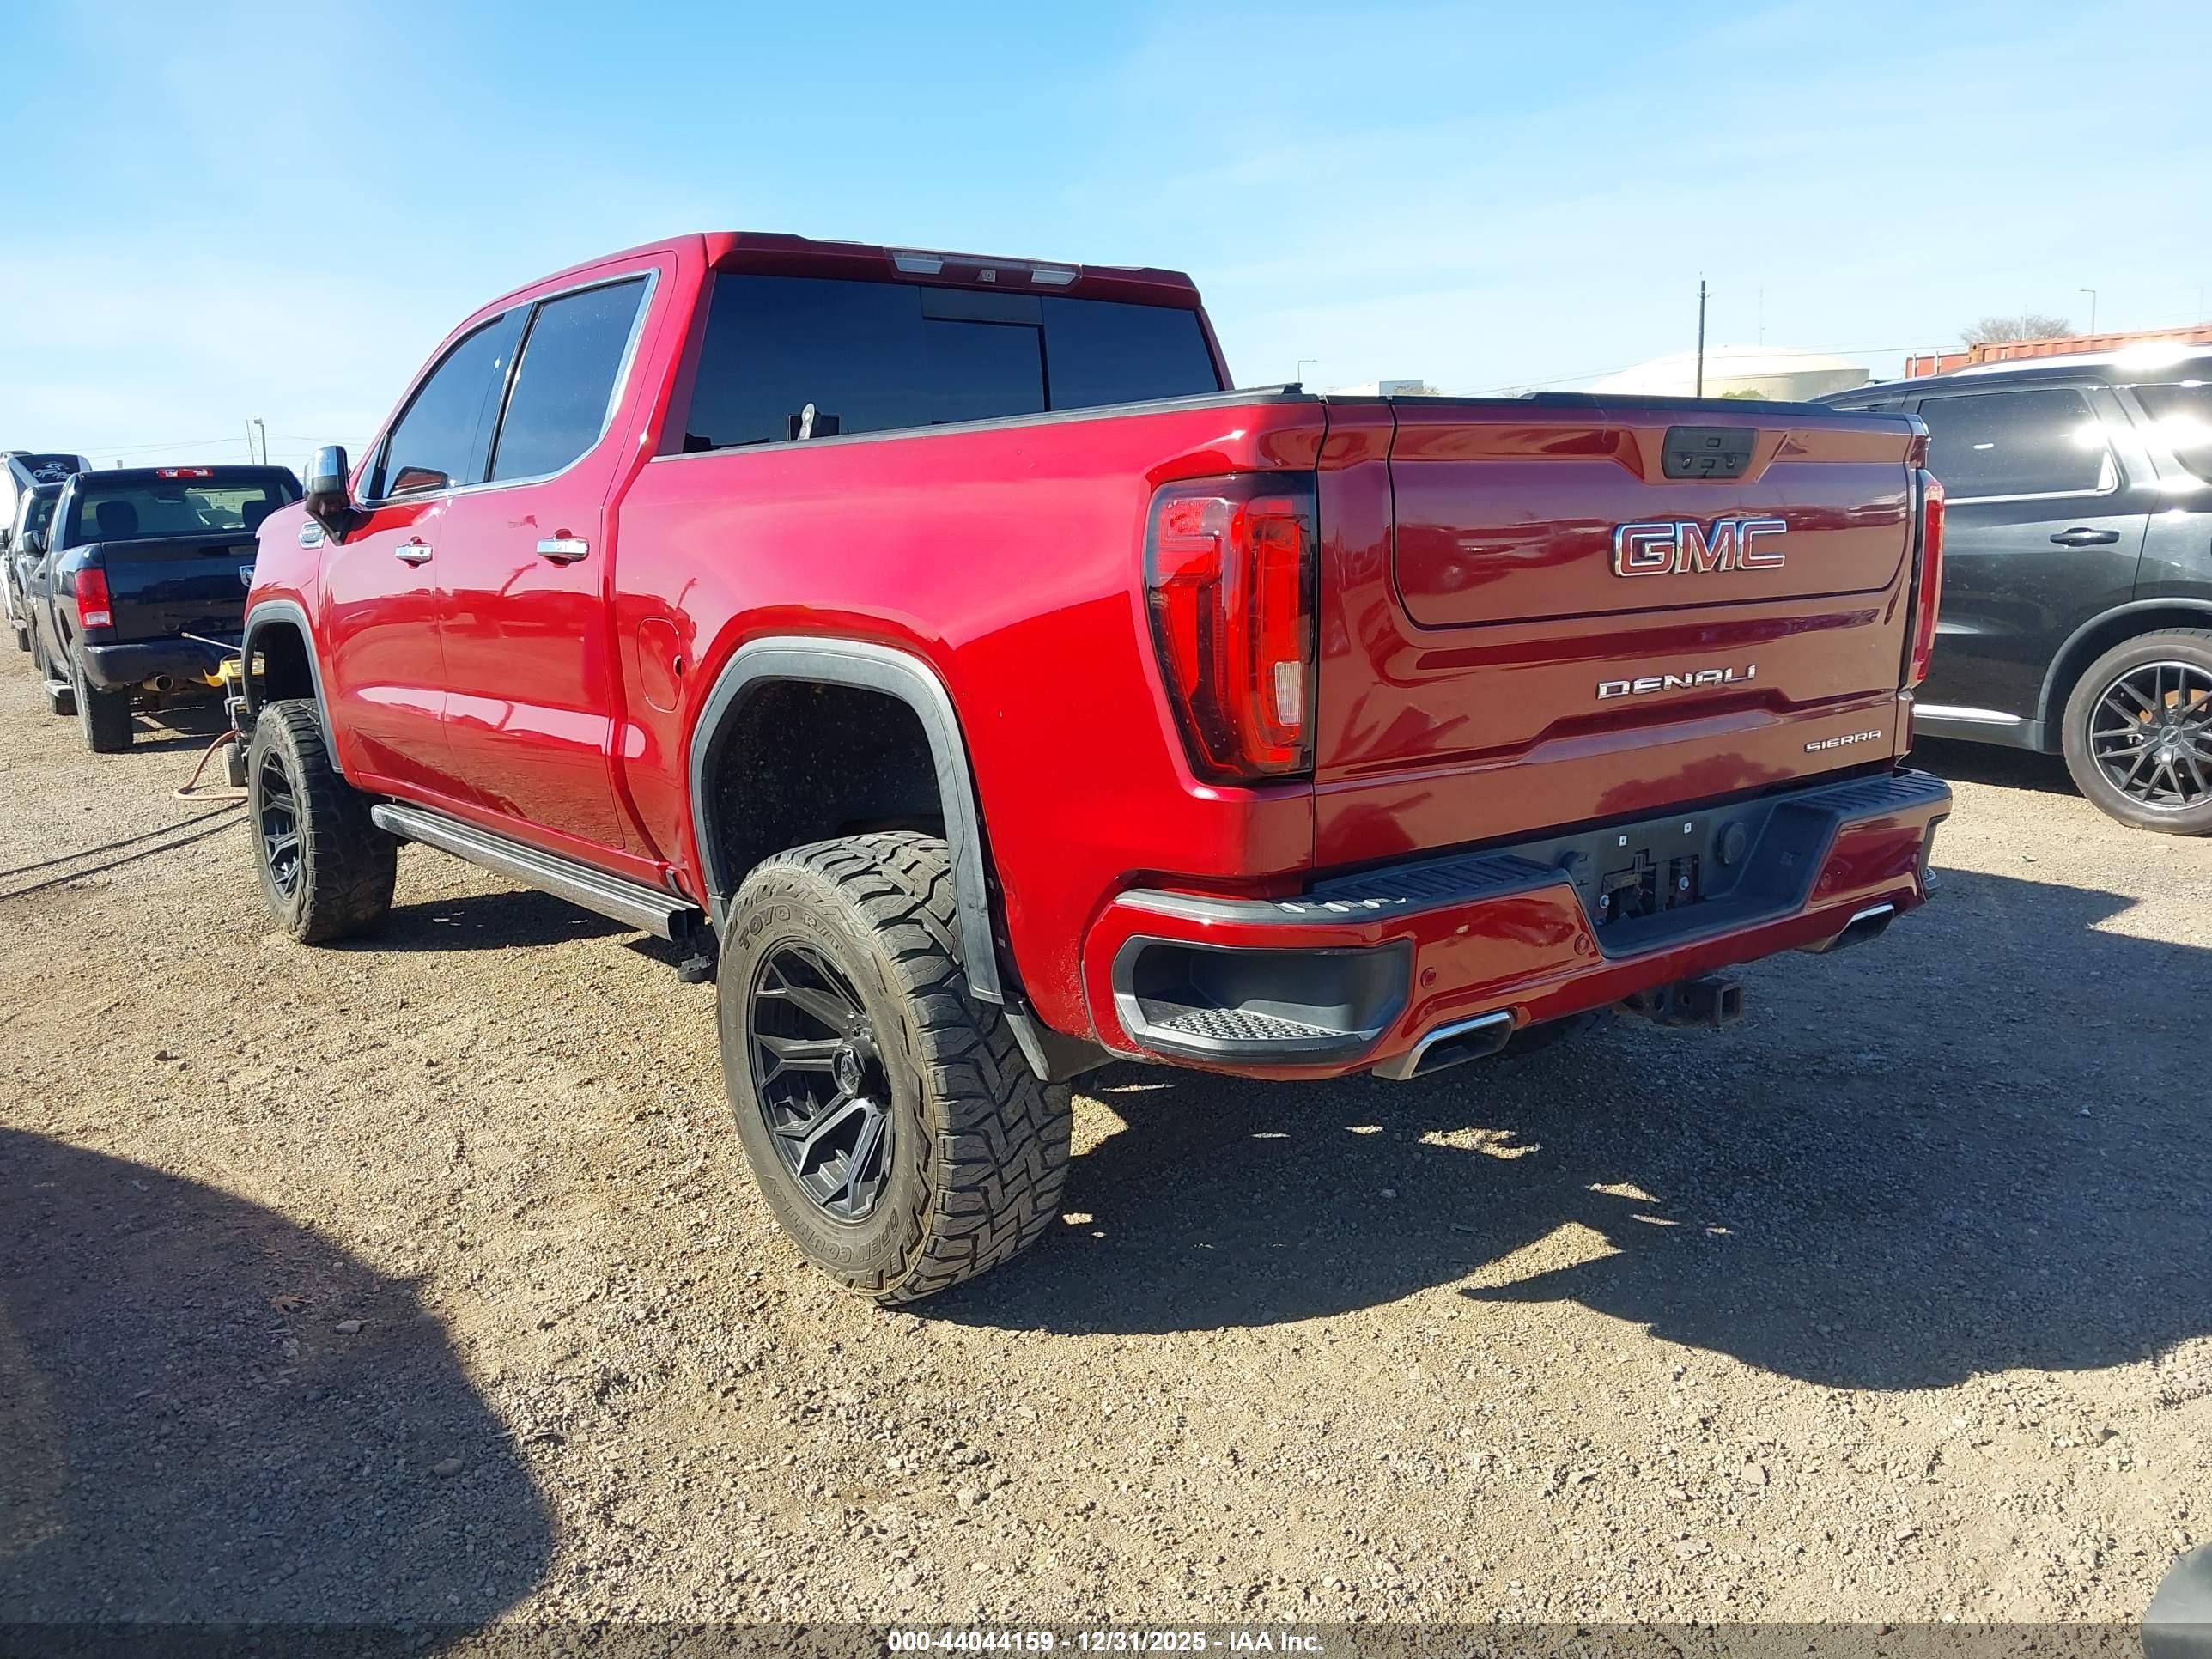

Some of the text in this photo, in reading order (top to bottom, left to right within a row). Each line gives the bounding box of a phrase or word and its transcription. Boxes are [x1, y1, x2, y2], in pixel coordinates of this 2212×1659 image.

[1614, 520, 1787, 577] GMC
[1597, 665, 1756, 700] DENALI
[1804, 729, 1881, 752] SIERRA
[738, 905, 791, 950] TOYO
